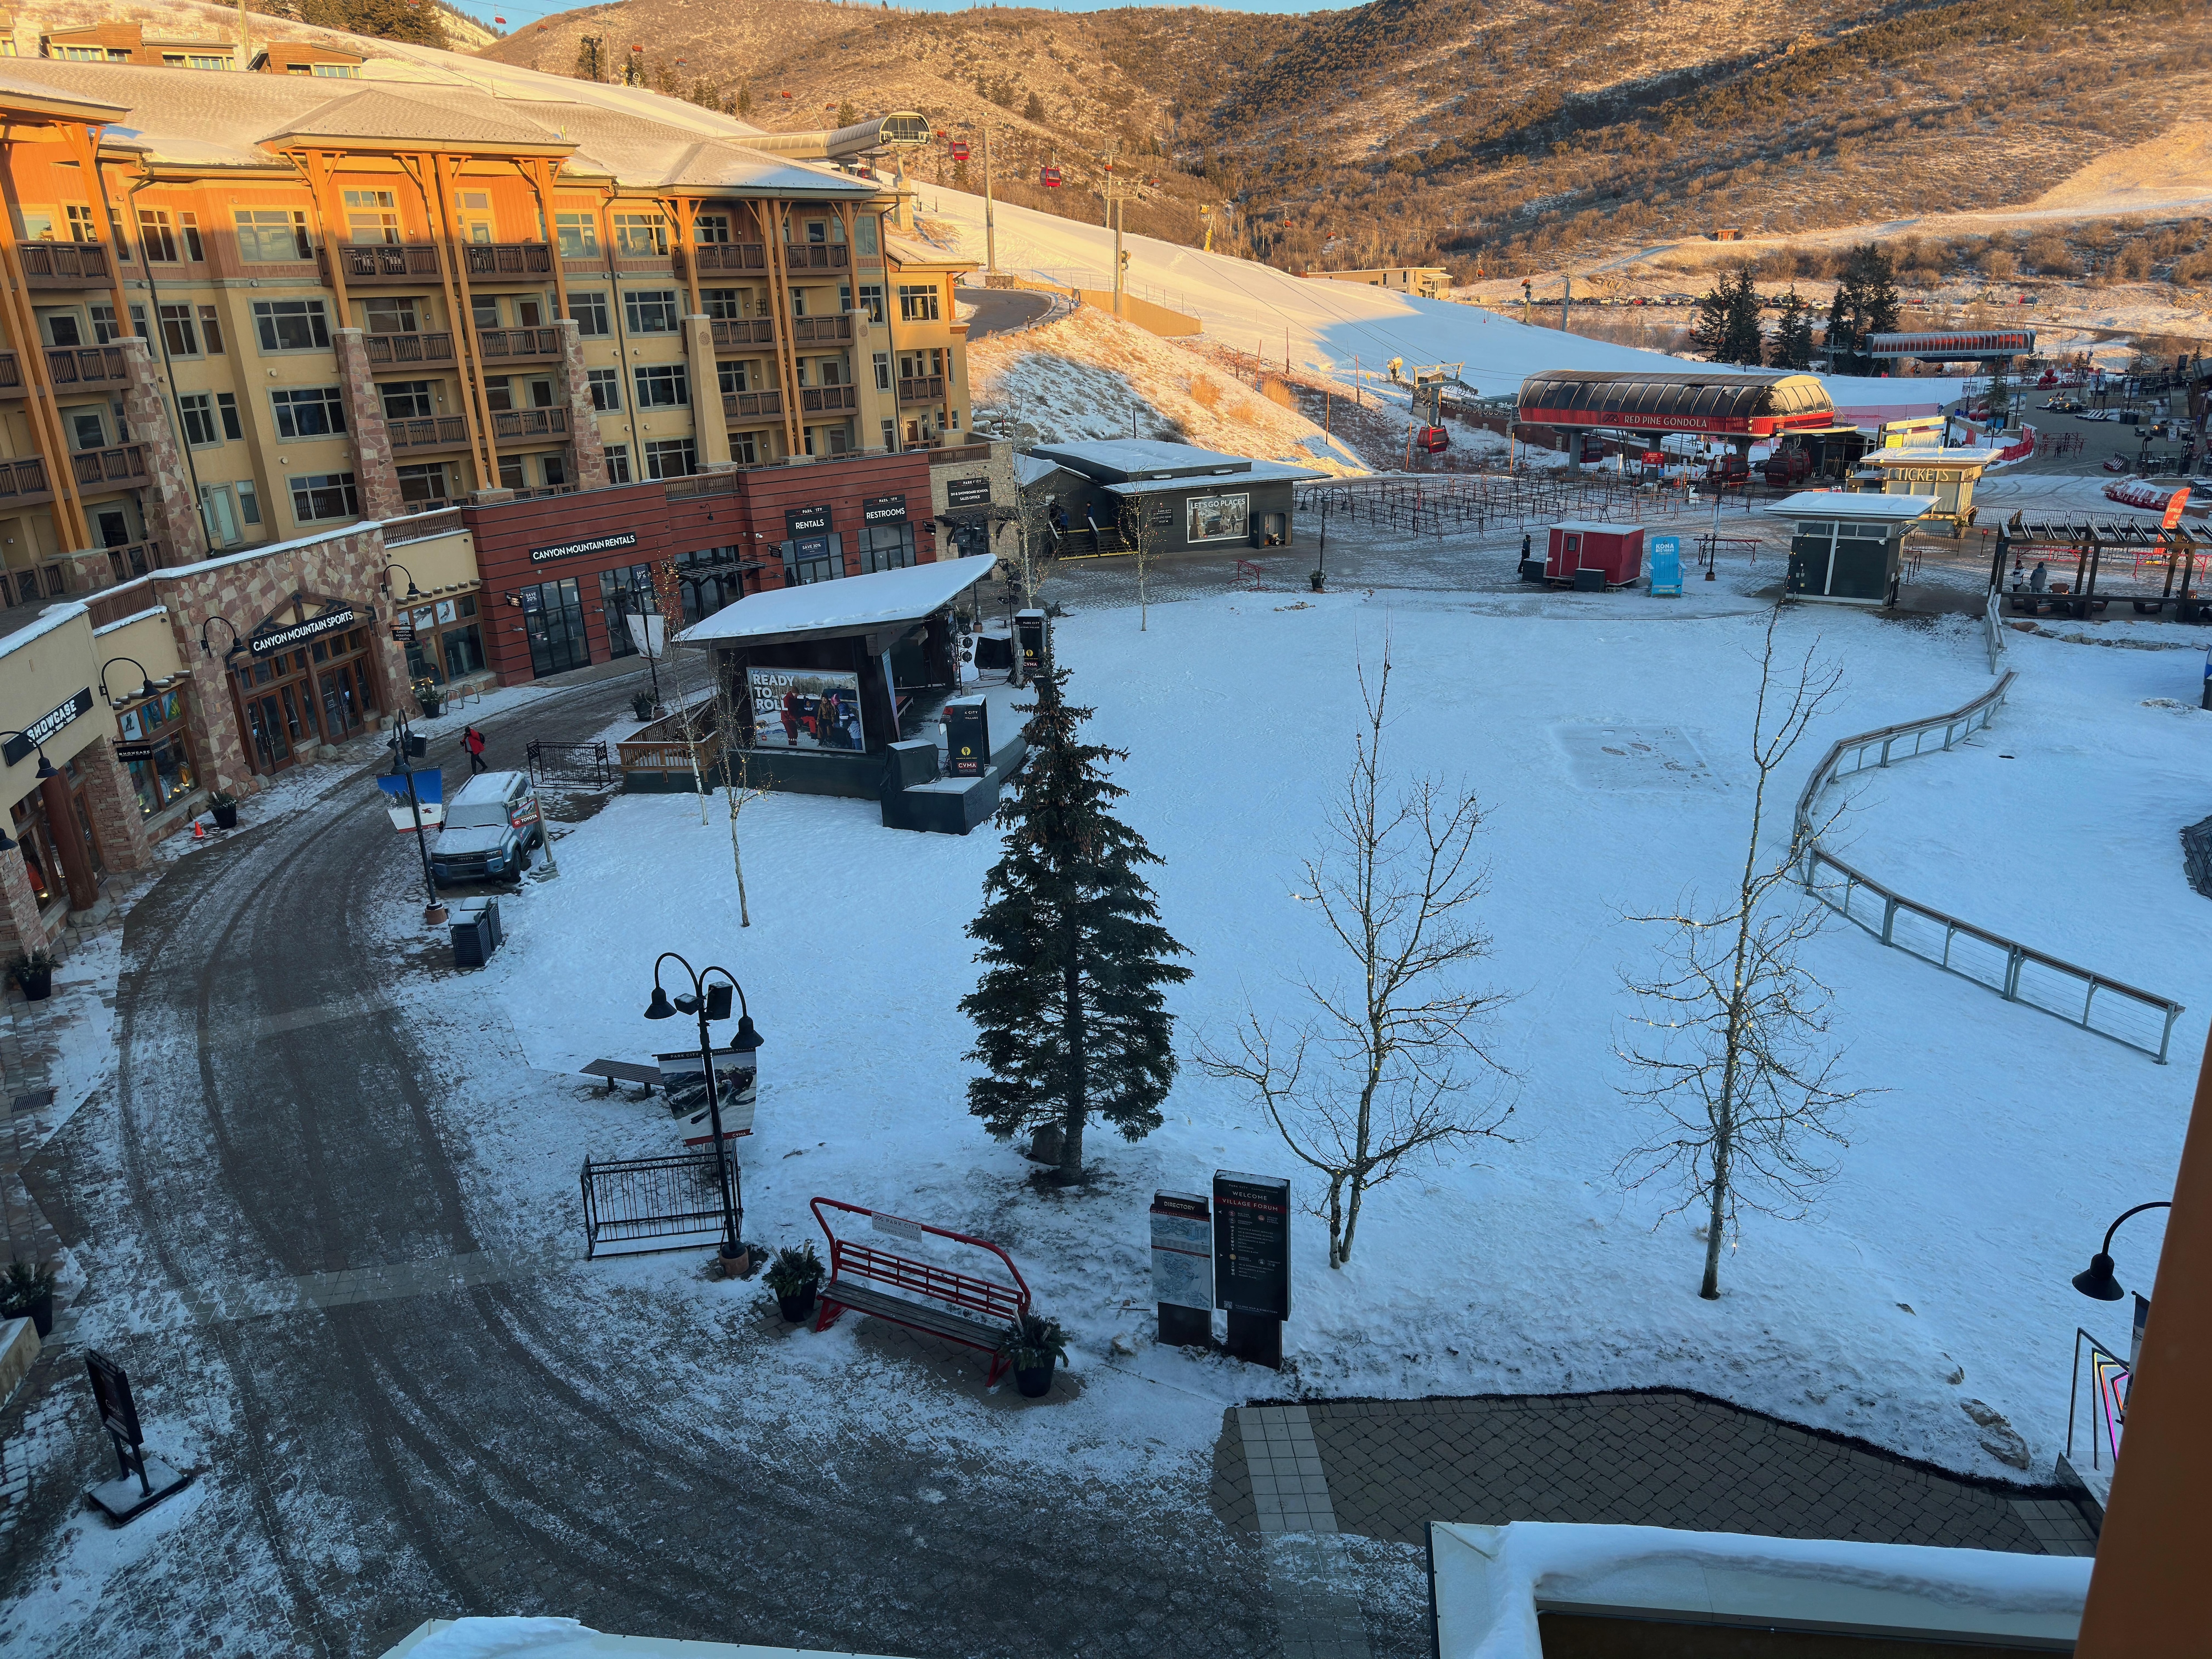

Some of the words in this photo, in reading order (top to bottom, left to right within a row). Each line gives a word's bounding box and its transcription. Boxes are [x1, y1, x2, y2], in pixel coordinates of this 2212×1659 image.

[1624, 415, 1640, 424] RED
[1643, 416, 1661, 425] PINE
[1663, 418, 1707, 428] GONDOLA
[1897, 468, 1950, 481] TICKETS
[1221, 498, 1245, 507] PLACES
[866, 507, 905, 519] RESTROOMS
[795, 519, 824, 530] RENTALS
[533, 547, 565, 560] CANYON
[566, 540, 604, 554] MOUNTAIN
[605, 535, 635, 547] RENTALS
[253, 632, 287, 651] CANYON
[288, 619, 327, 641] MOUNTAIN
[326, 611, 353, 628] SPORTS
[753, 674, 795, 687] READY
[755, 687, 772, 698] TO
[756, 699, 788, 711] ROLL
[27, 699, 77, 742] SHOWCASE
[521, 814, 538, 823] TOYOTA
[1233, 1191, 1267, 1201] WELCOME
[1164, 1202, 1195, 1210] DIRECTORY
[1222, 1198, 1251, 1207] VILLAGE
[1254, 1203, 1278, 1211] FORUM
[886, 1218, 902, 1227] PARK
[874, 1225, 897, 1234] CANYONS
[899, 1232, 918, 1240] VILLAGE
